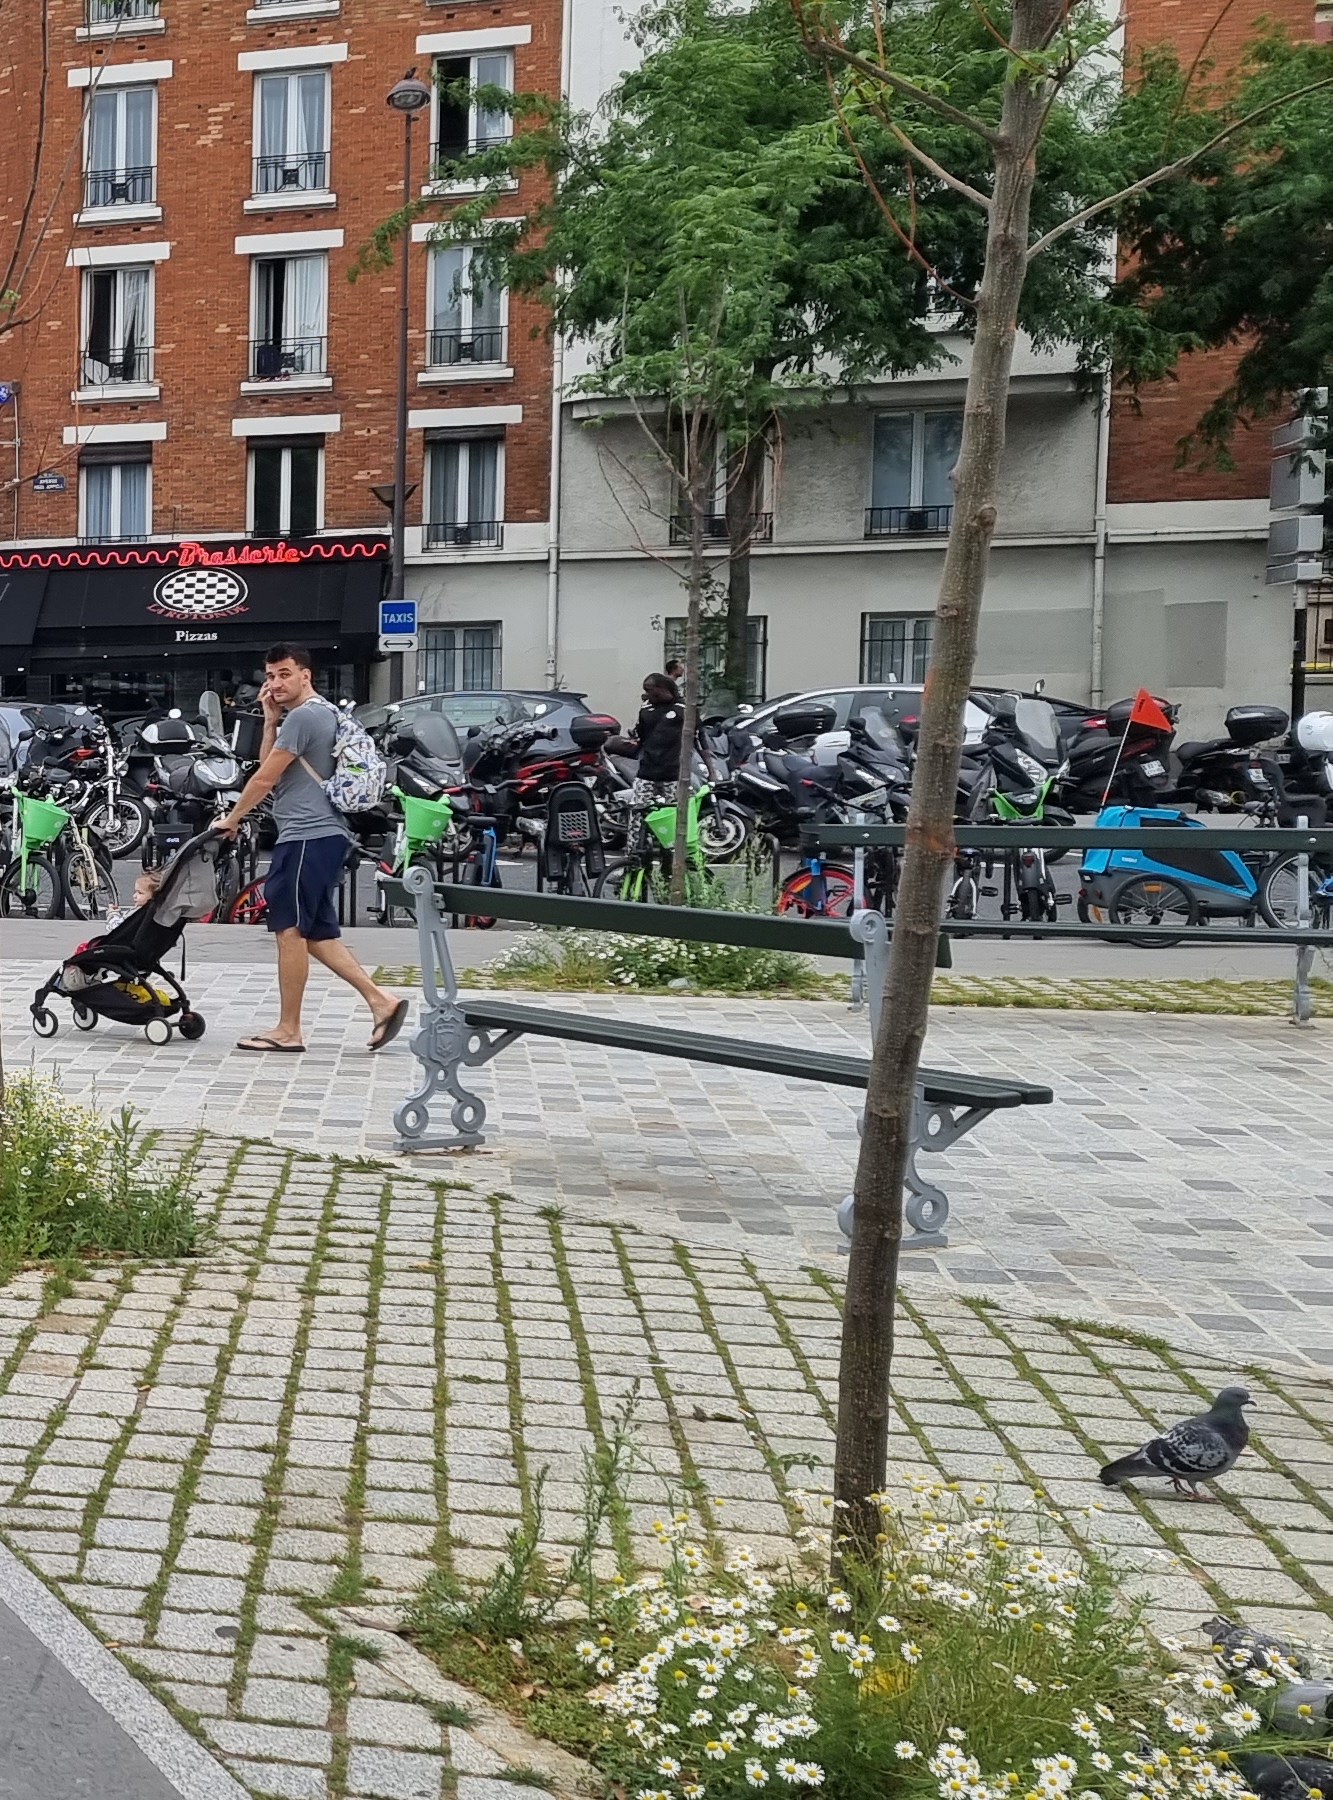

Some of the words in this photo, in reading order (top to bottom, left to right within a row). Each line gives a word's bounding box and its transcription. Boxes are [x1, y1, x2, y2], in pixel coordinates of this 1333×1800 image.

[178, 542, 301, 566] Brasserie
[164, 604, 249, 620] ROTONDE
[383, 613, 414, 624] TAXIS
[174, 630, 218, 642] Pizzas
